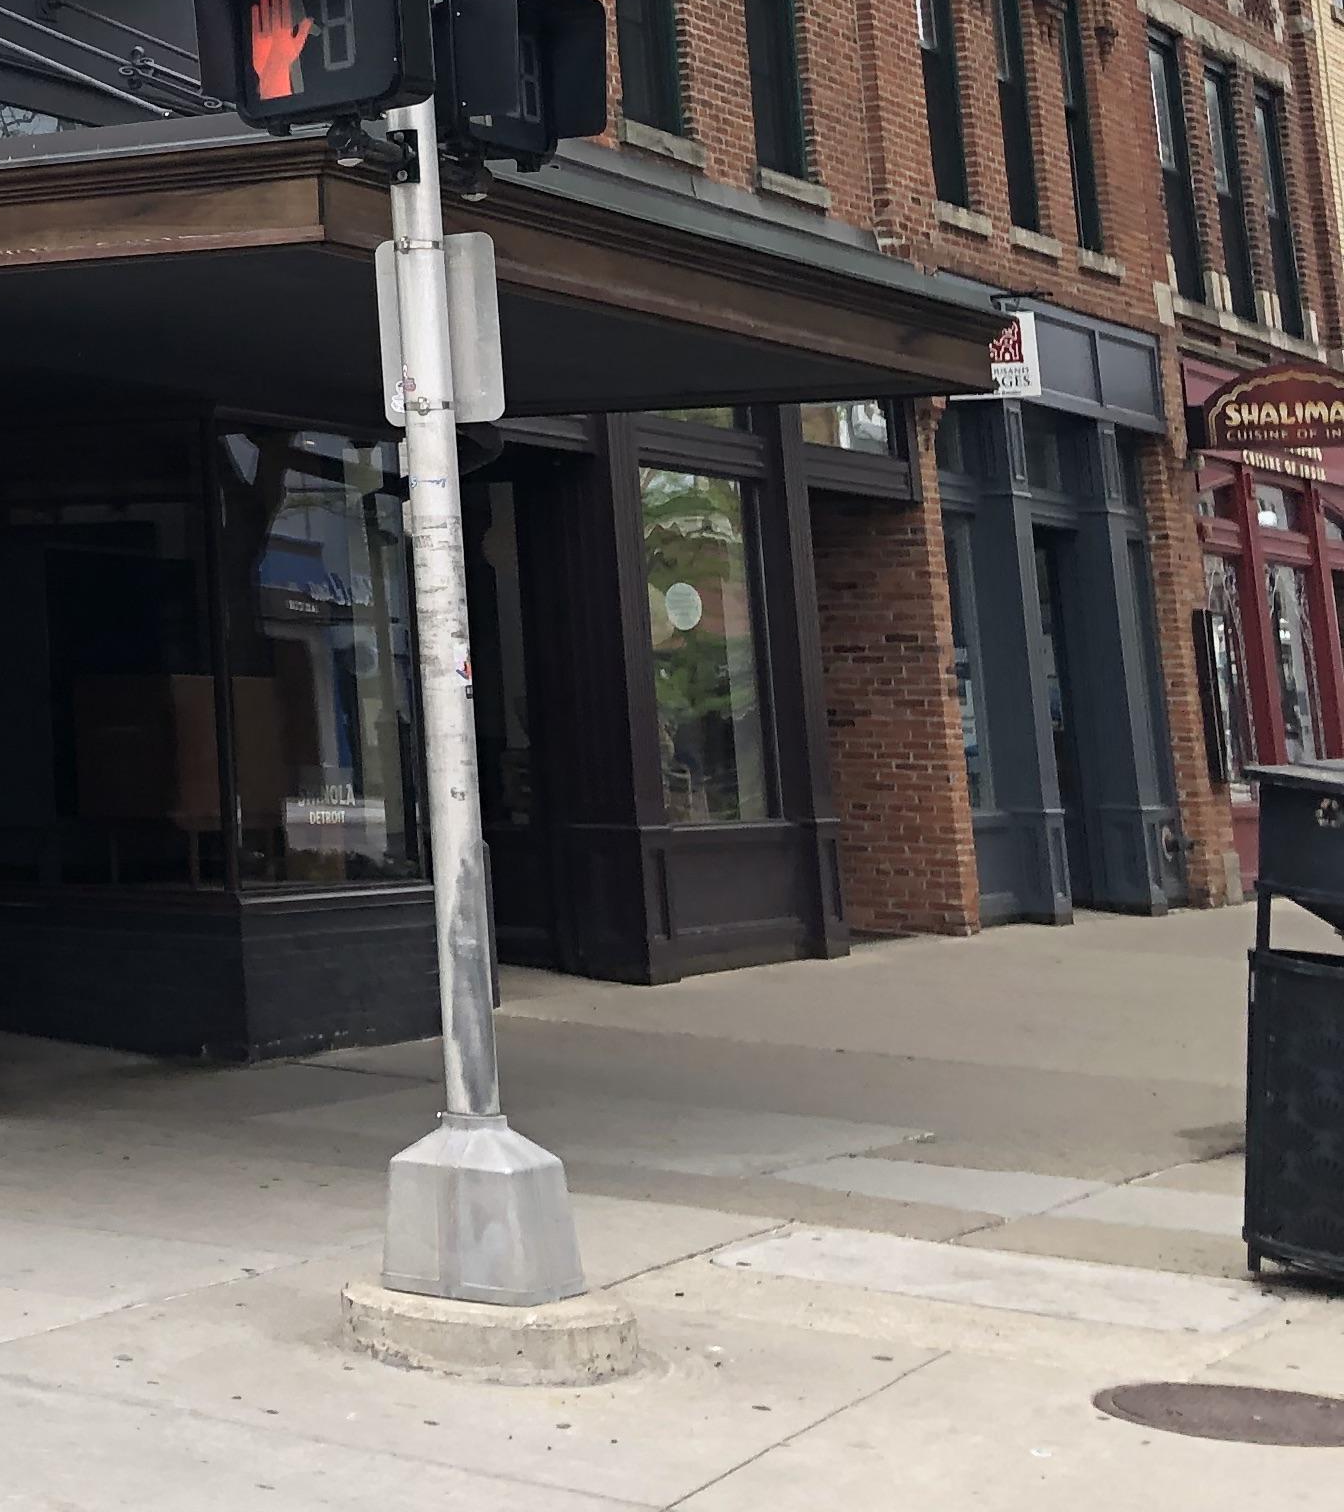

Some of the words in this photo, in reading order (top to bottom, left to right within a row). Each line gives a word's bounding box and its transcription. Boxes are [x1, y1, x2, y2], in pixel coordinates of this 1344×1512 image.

[1225, 400, 1344, 427] SHALIMA
[1226, 429, 1288, 442] CUISINE
[1297, 428, 1317, 440] OF
[310, 810, 345, 824] DETROIT
